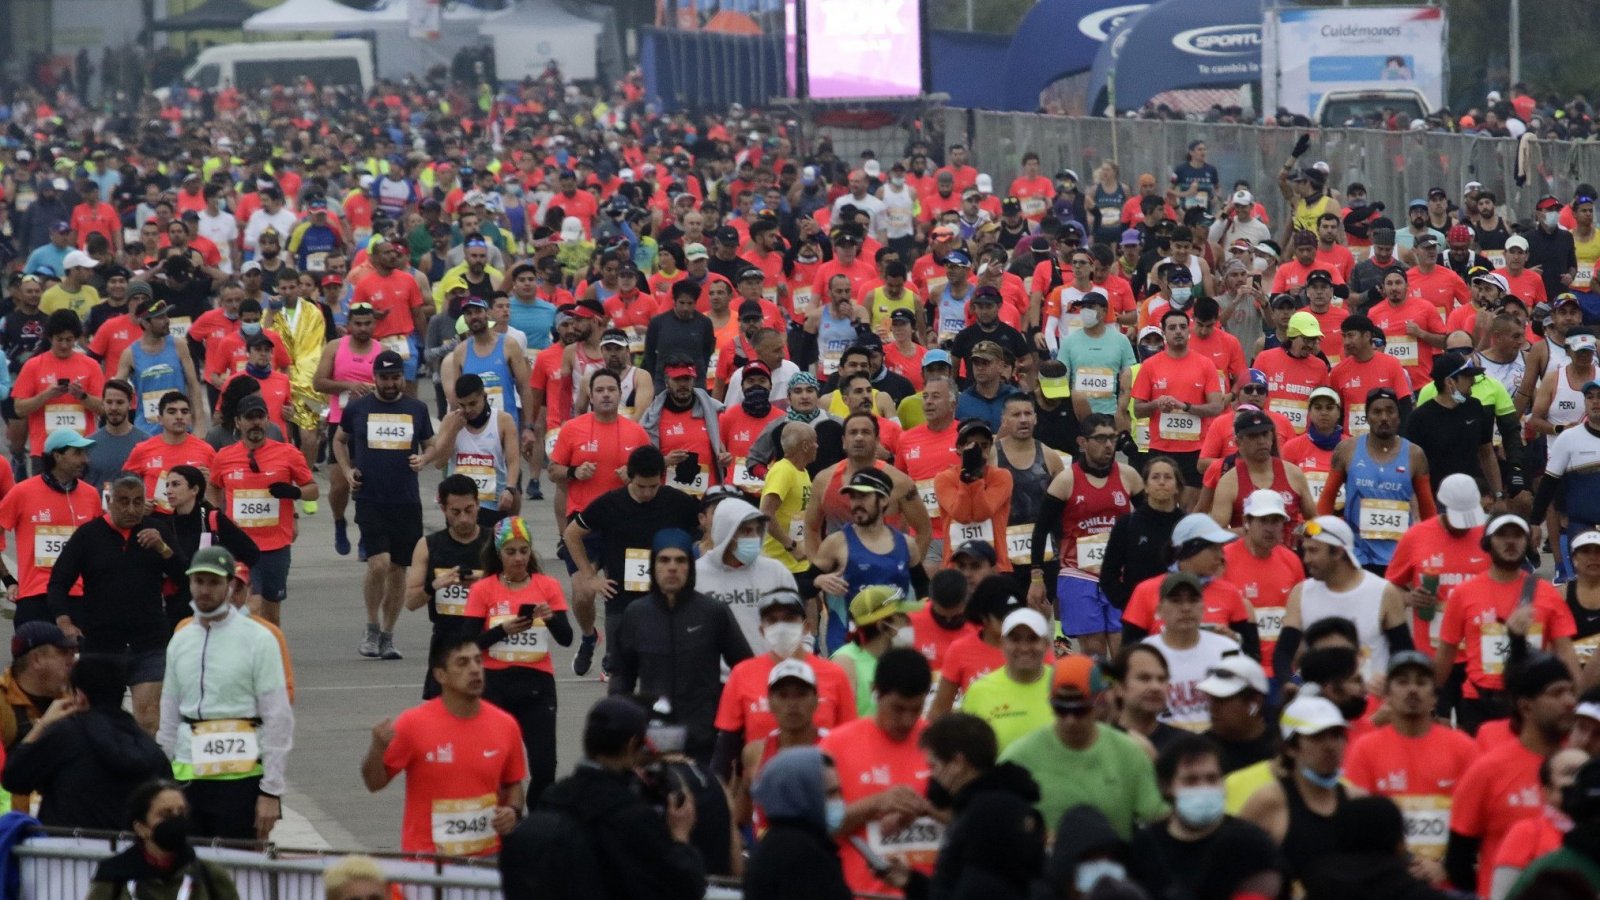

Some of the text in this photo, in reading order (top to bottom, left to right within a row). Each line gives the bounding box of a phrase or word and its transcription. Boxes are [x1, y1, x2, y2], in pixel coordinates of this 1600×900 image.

[1320, 23, 1401, 38] Cuidémonos
[1196, 33, 1262, 48] SPORTL
[1199, 64, 1259, 74] Te cambia la
[1388, 346, 1410, 356] 4691
[1081, 378, 1107, 388] 4408
[1558, 401, 1576, 410] PERU
[56, 415, 76, 427] 2112
[1166, 417, 1193, 429] 2389
[375, 426, 406, 437] 4443
[1355, 478, 1374, 488] RUN
[241, 502, 271, 515] 2684
[1078, 515, 1115, 530] CHILLÁ
[1370, 513, 1401, 527] 3343
[961, 525, 983, 538] 1511
[502, 633, 538, 646] 4935
[203, 738, 246, 755] 4872
